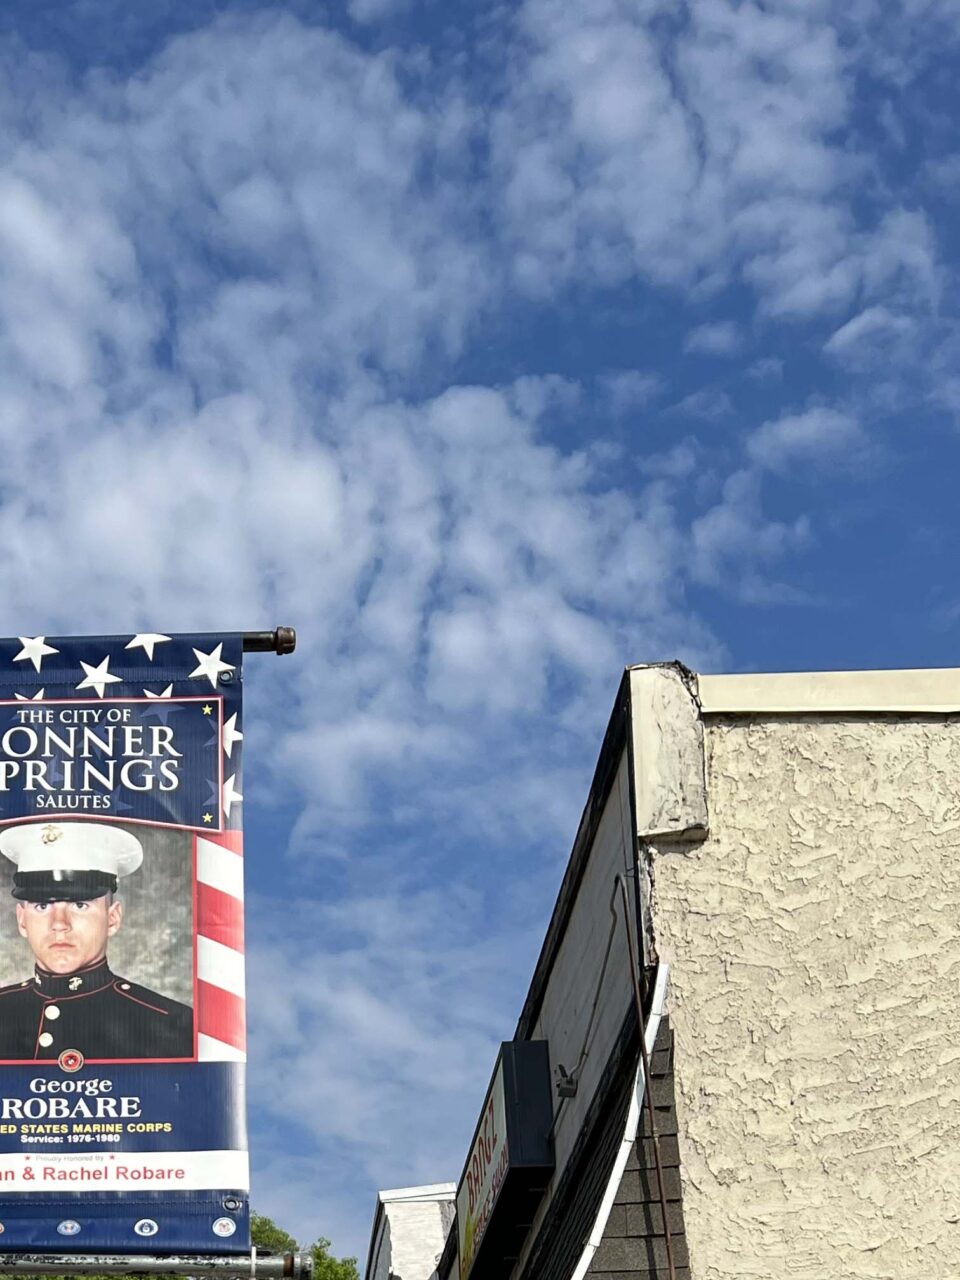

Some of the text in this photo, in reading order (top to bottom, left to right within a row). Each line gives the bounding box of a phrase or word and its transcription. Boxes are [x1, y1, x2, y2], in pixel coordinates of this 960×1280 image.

[17, 708, 131, 724] THE CITY OF
[36, 794, 111, 809] SALUTES
[29, 1078, 113, 1096] George
[1, 1096, 142, 1119] ROBARE
[21, 1124, 68, 1134] STATES
[72, 1123, 123, 1133] MARINE
[127, 1122, 172, 1133] CORPS
[21, 1133, 120, 1144] Service: 1976-1980
[22, 1167, 36, 1181] &
[43, 1166, 108, 1181] Rachel
[116, 1166, 185, 1180] Robare
